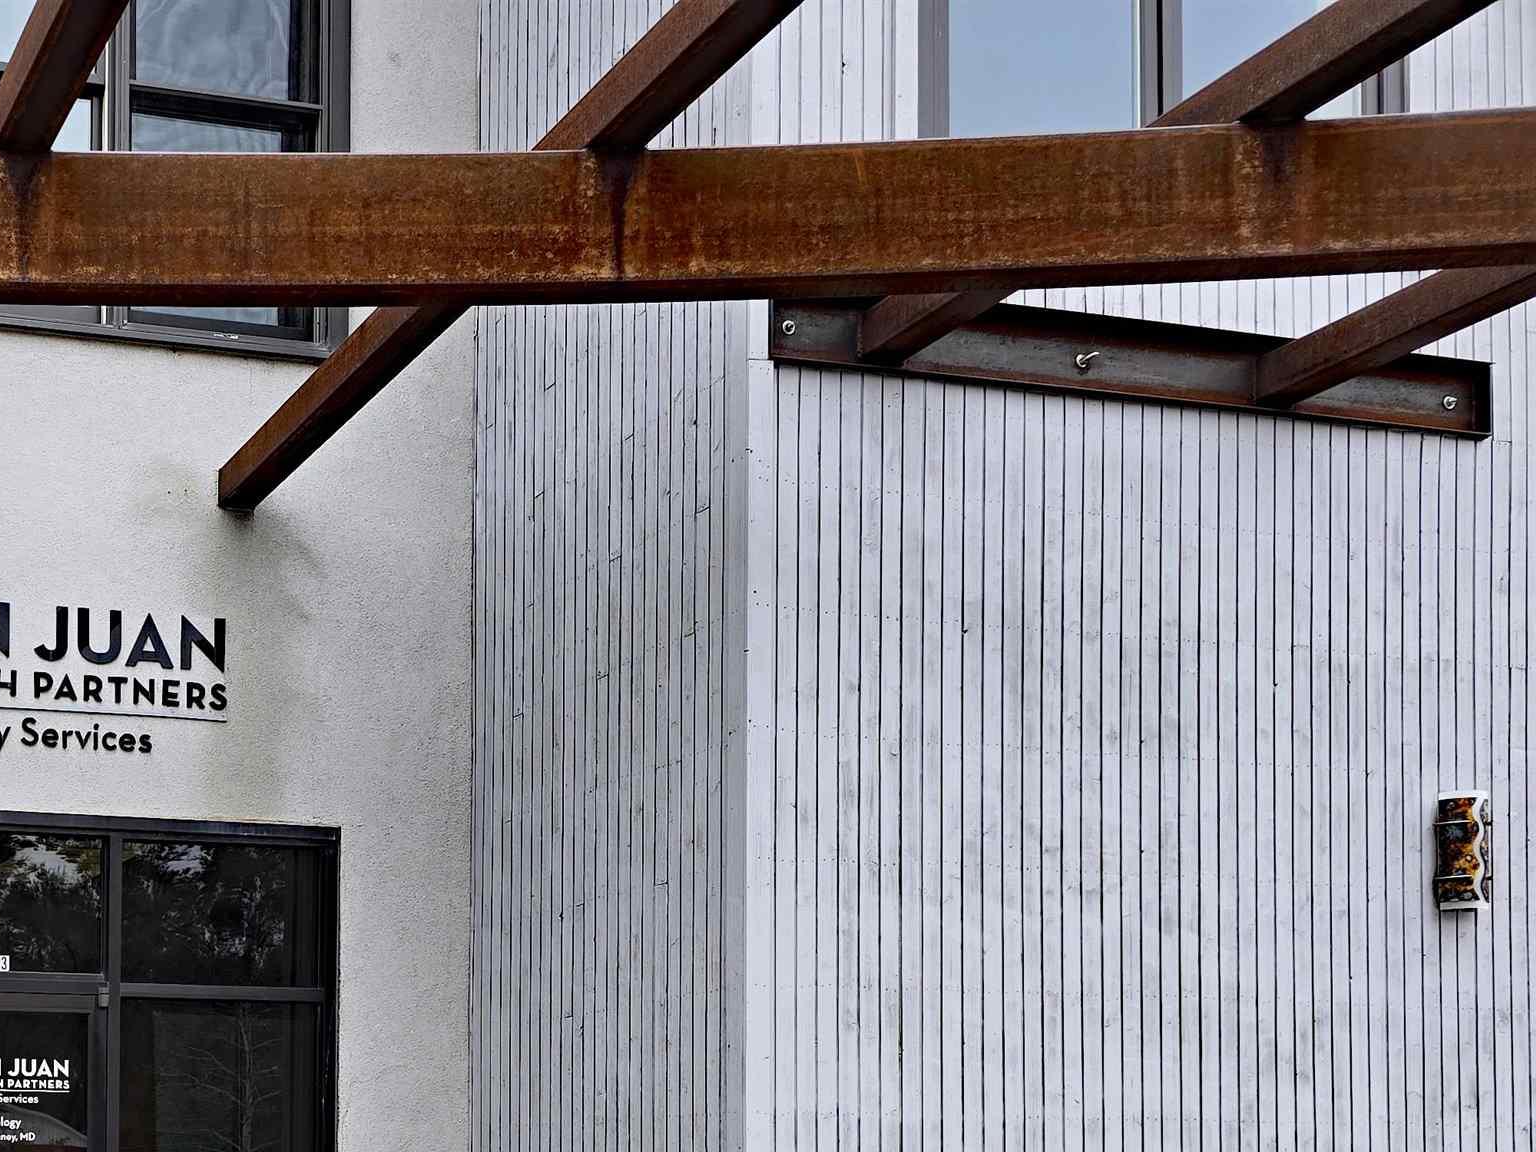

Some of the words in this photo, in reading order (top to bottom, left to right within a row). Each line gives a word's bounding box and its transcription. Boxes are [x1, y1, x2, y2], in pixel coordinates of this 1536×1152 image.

[34, 605, 227, 673] JUAN
[34, 671, 227, 711] PARTNERS
[21, 717, 153, 753] Services
[7, 1058, 70, 1078] JUAN
[8, 1078, 70, 1089] PARTNERS
[20, 1132, 36, 1141] MD
